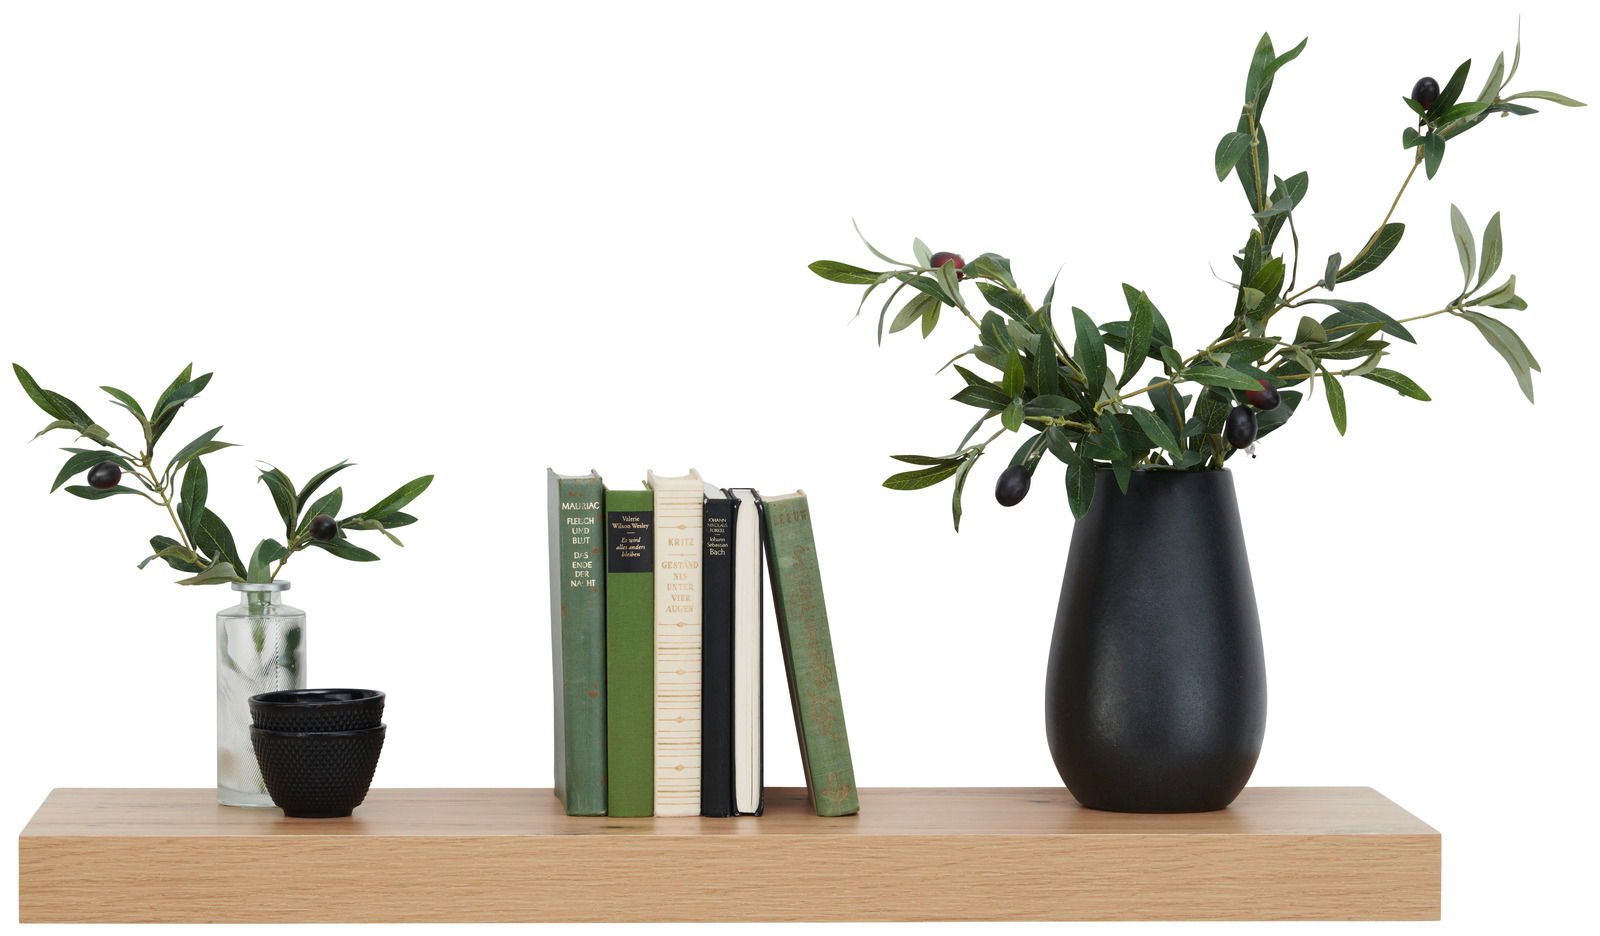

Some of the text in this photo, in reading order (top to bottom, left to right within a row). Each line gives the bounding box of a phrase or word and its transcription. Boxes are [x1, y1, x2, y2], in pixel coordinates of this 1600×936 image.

[561, 502, 600, 510] MAURIAC
[631, 522, 650, 531] Wesley
[571, 527, 590, 535] UND
[572, 537, 591, 545] BLUT
[668, 538, 695, 546] KRITZ
[709, 548, 726, 556] Bach
[571, 561, 593, 569] ENDE
[570, 580, 596, 588] NAHT
